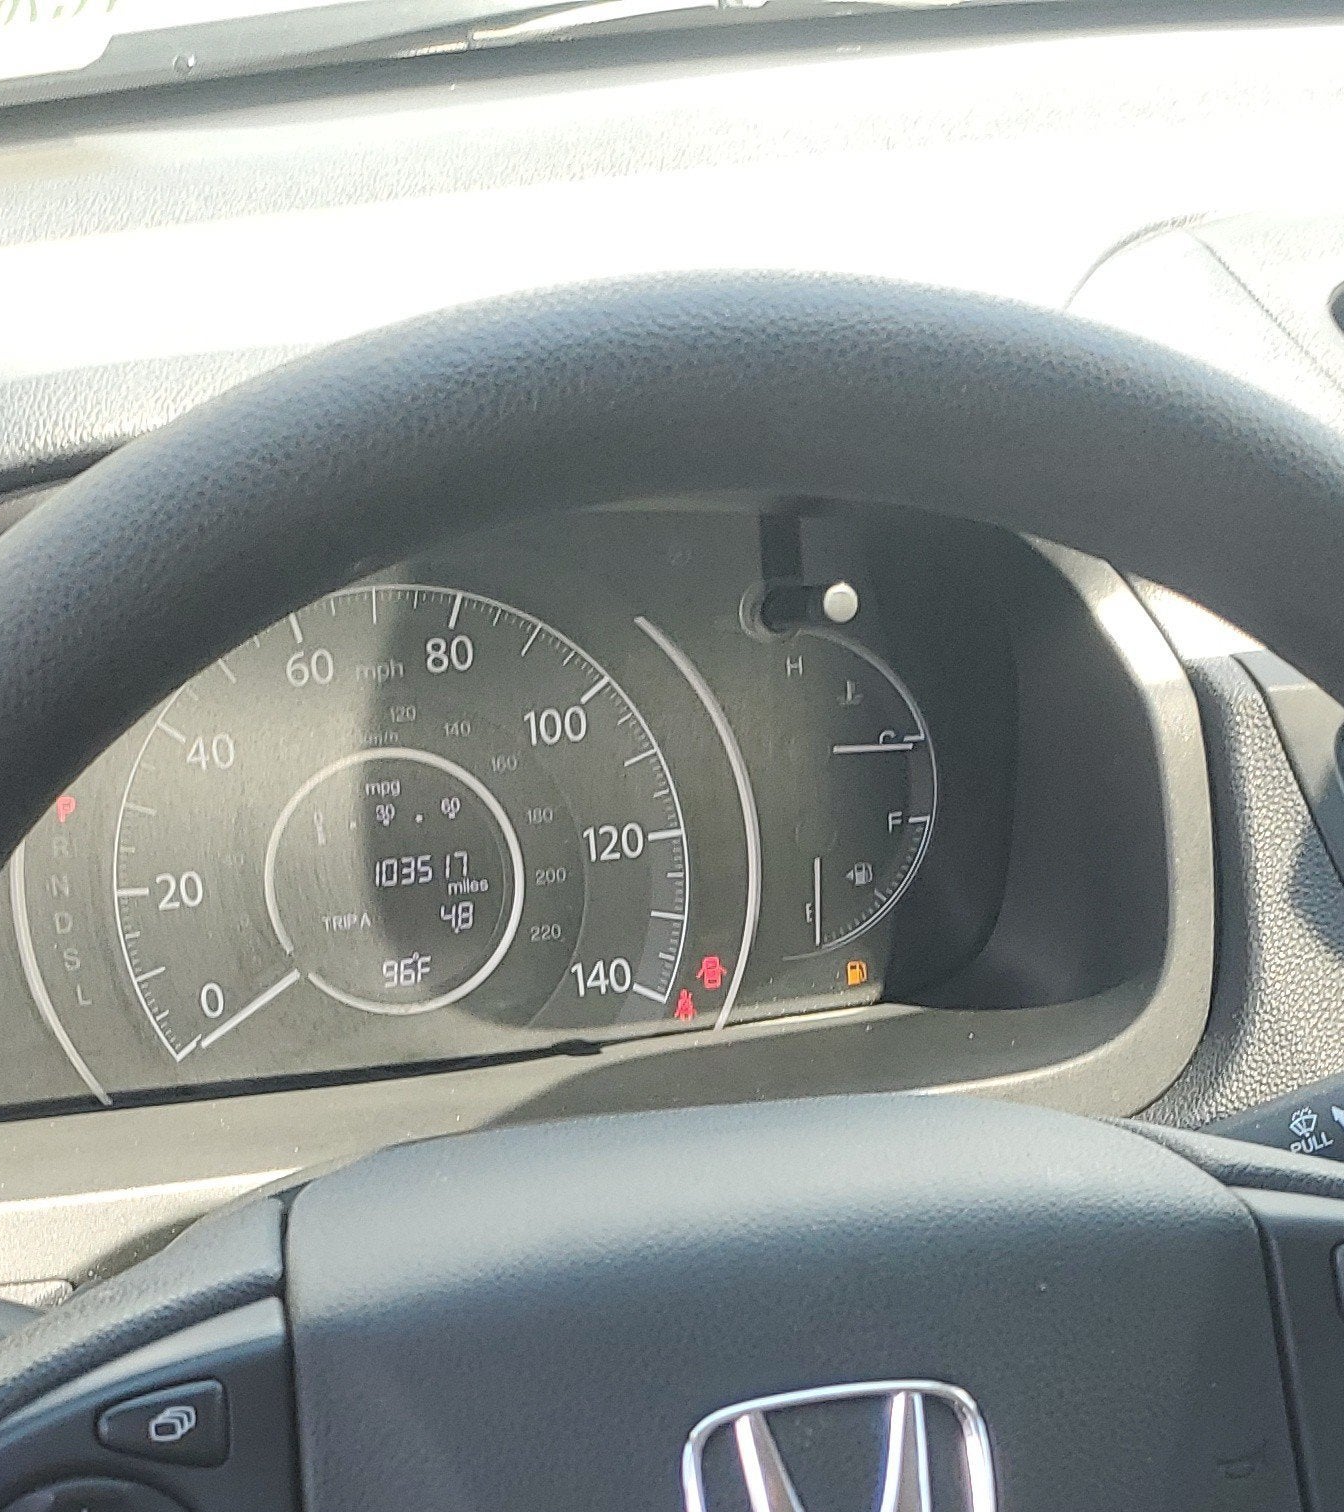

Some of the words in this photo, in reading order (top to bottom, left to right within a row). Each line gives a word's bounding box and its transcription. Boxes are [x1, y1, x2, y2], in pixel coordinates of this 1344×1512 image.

[425, 635, 474, 674] 80
[286, 649, 334, 687] 60
[356, 658, 404, 680] mph
[787, 655, 803, 677] H
[389, 706, 416, 722] 120
[444, 722, 471, 737] 140
[523, 706, 587, 746] 100
[186, 732, 235, 770] 40
[365, 780, 401, 798] mpg
[55, 795, 76, 822] P
[888, 811, 902, 833] F
[582, 822, 644, 862] 120
[448, 877, 489, 896] miles
[535, 867, 566, 885] 200
[156, 870, 203, 911] 20
[55, 911, 73, 935] D
[323, 914, 357, 932] TRIP
[360, 913, 372, 930] A
[531, 924, 562, 942] 220
[64, 948, 82, 971] S
[571, 957, 632, 998] 140
[77, 984, 93, 1006] L
[201, 982, 224, 1018] 0
[1290, 1135, 1334, 1155] PULL
